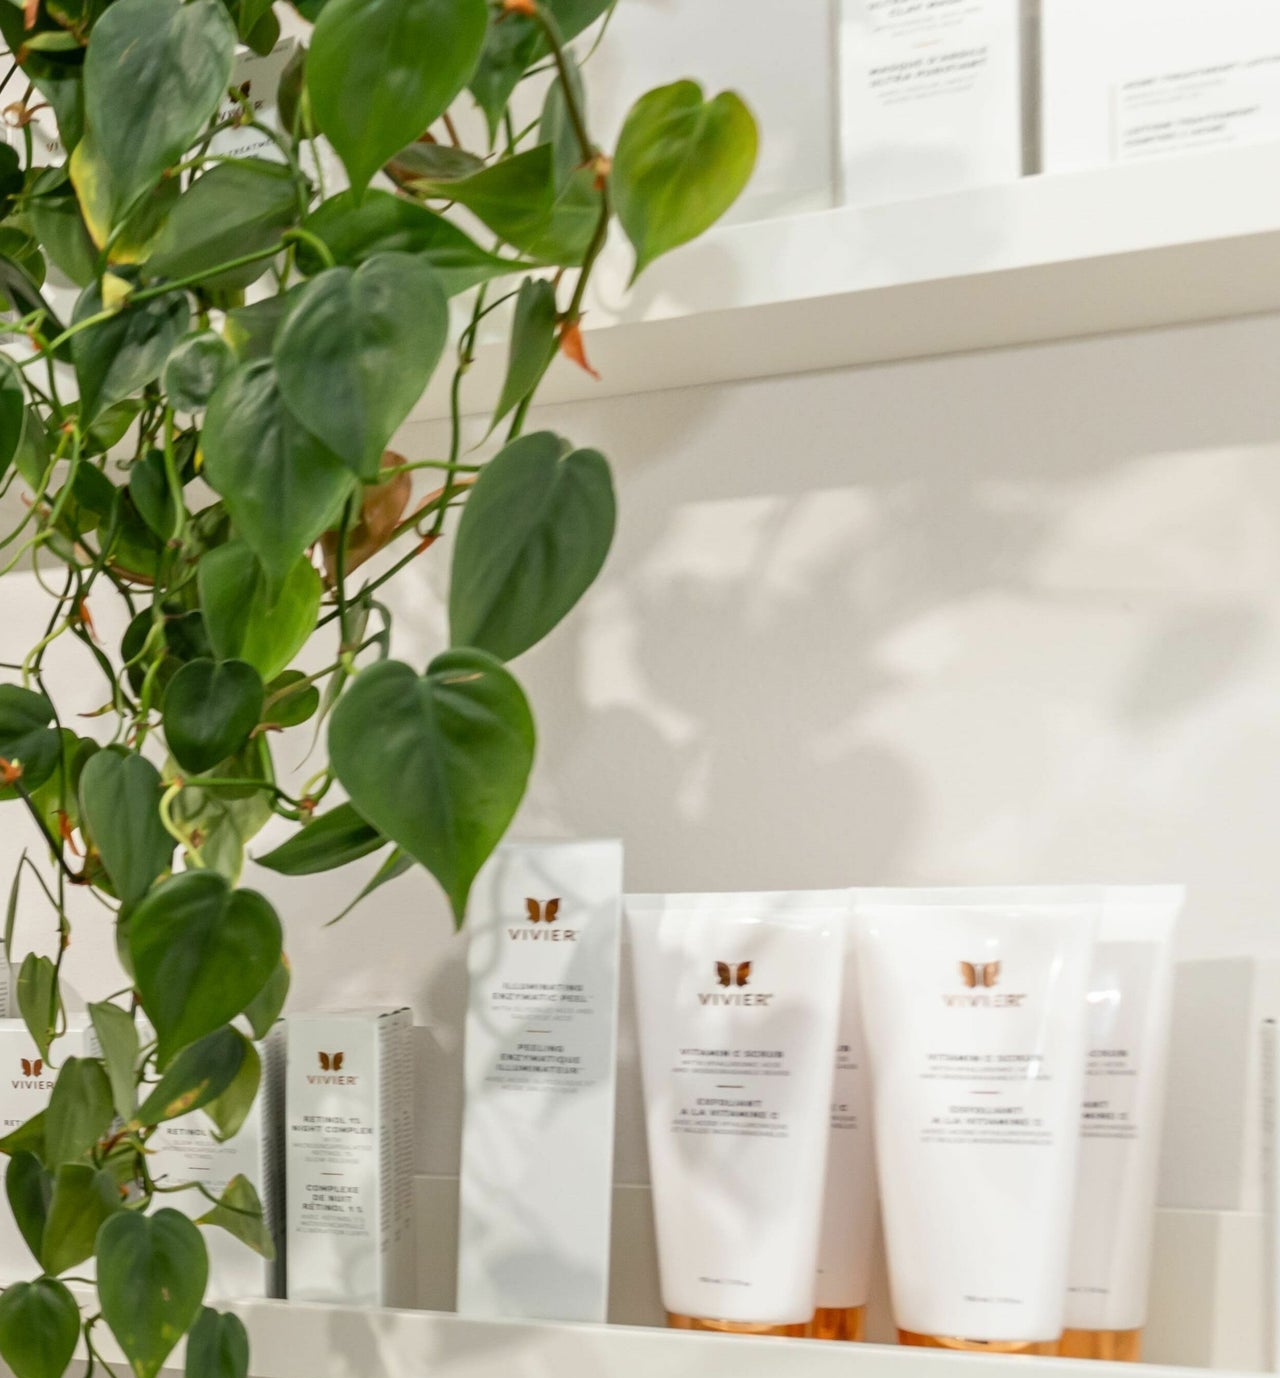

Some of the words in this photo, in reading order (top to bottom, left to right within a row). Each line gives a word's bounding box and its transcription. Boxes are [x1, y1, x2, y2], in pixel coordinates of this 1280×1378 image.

[508, 929, 576, 941] VIVIER
[698, 993, 769, 1006] VIVIER
[11, 1080, 53, 1090] VIVIER
[307, 1075, 356, 1085] VIVIER
